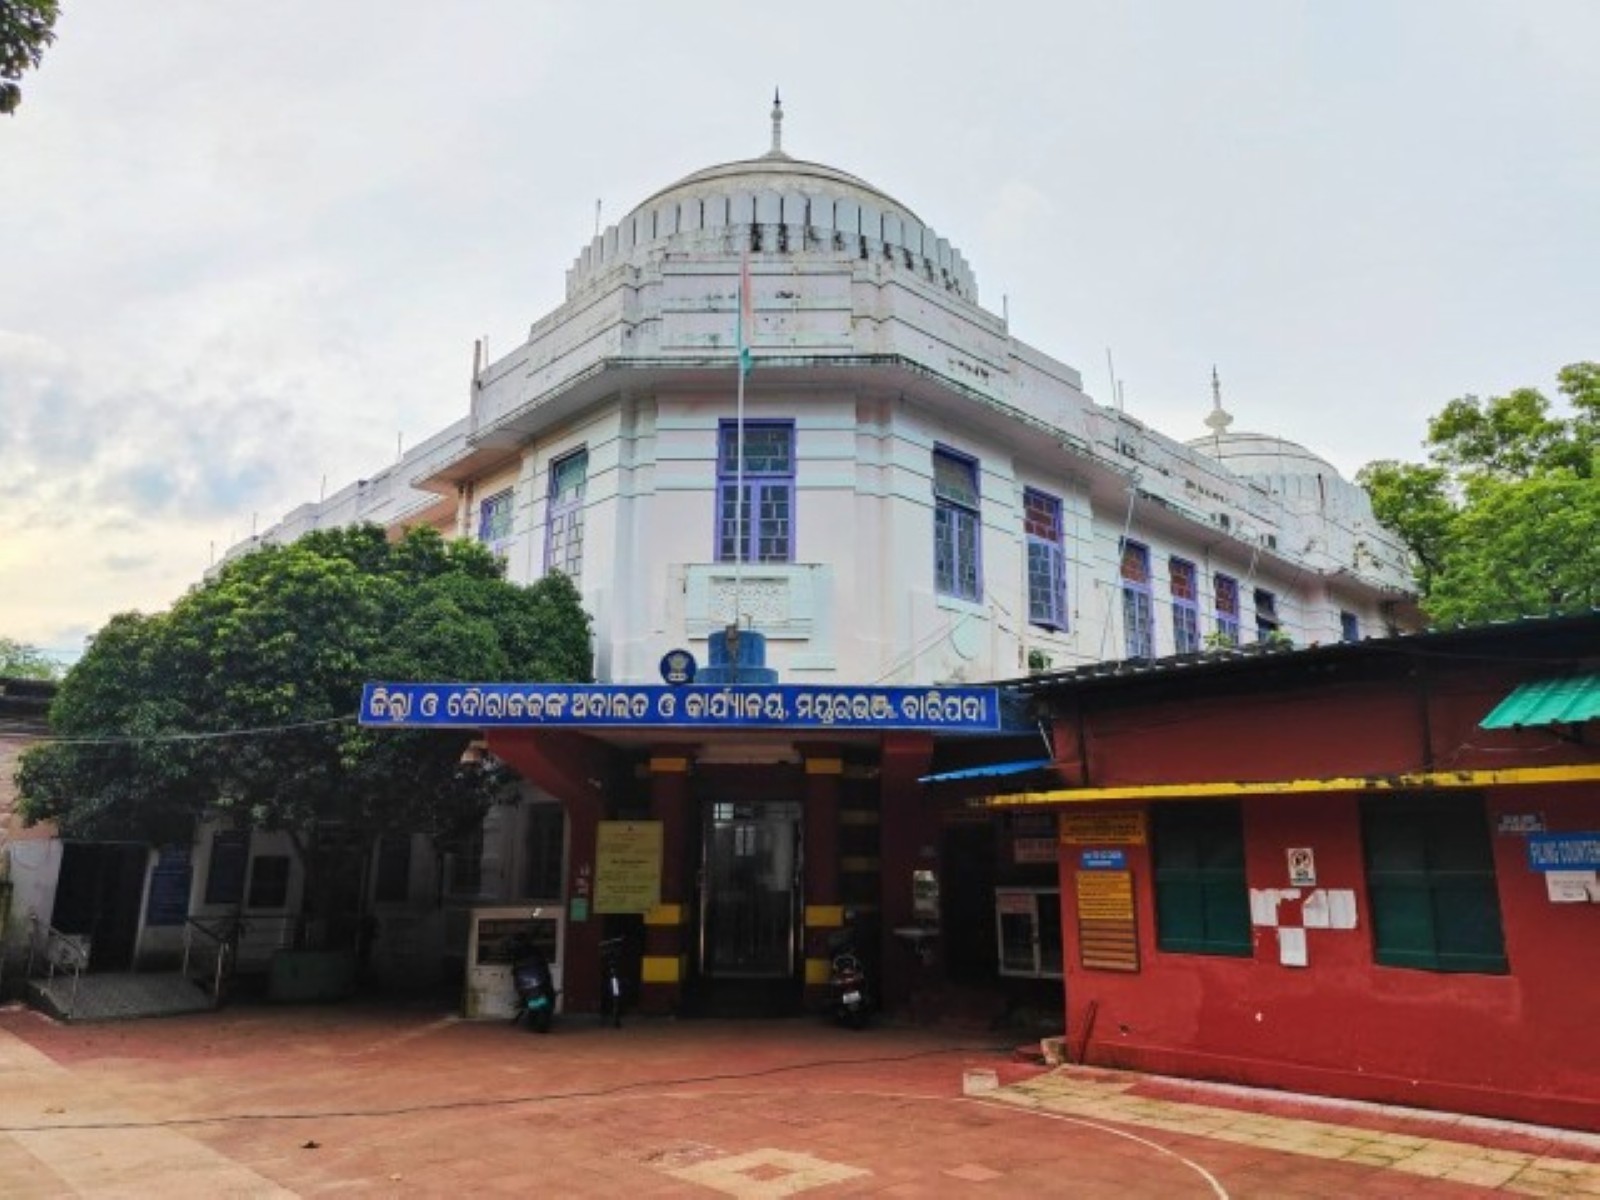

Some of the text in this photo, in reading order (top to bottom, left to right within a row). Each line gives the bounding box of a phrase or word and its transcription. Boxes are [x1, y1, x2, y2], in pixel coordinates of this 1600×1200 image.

[371, 687, 413, 721] ଜିଲ୍ଲା
[420, 692, 439, 717] ଓ
[570, 692, 649, 719] ଅଦାଲତ
[658, 692, 676, 717] ଓ
[901, 690, 987, 722] ବାରିପଦା
